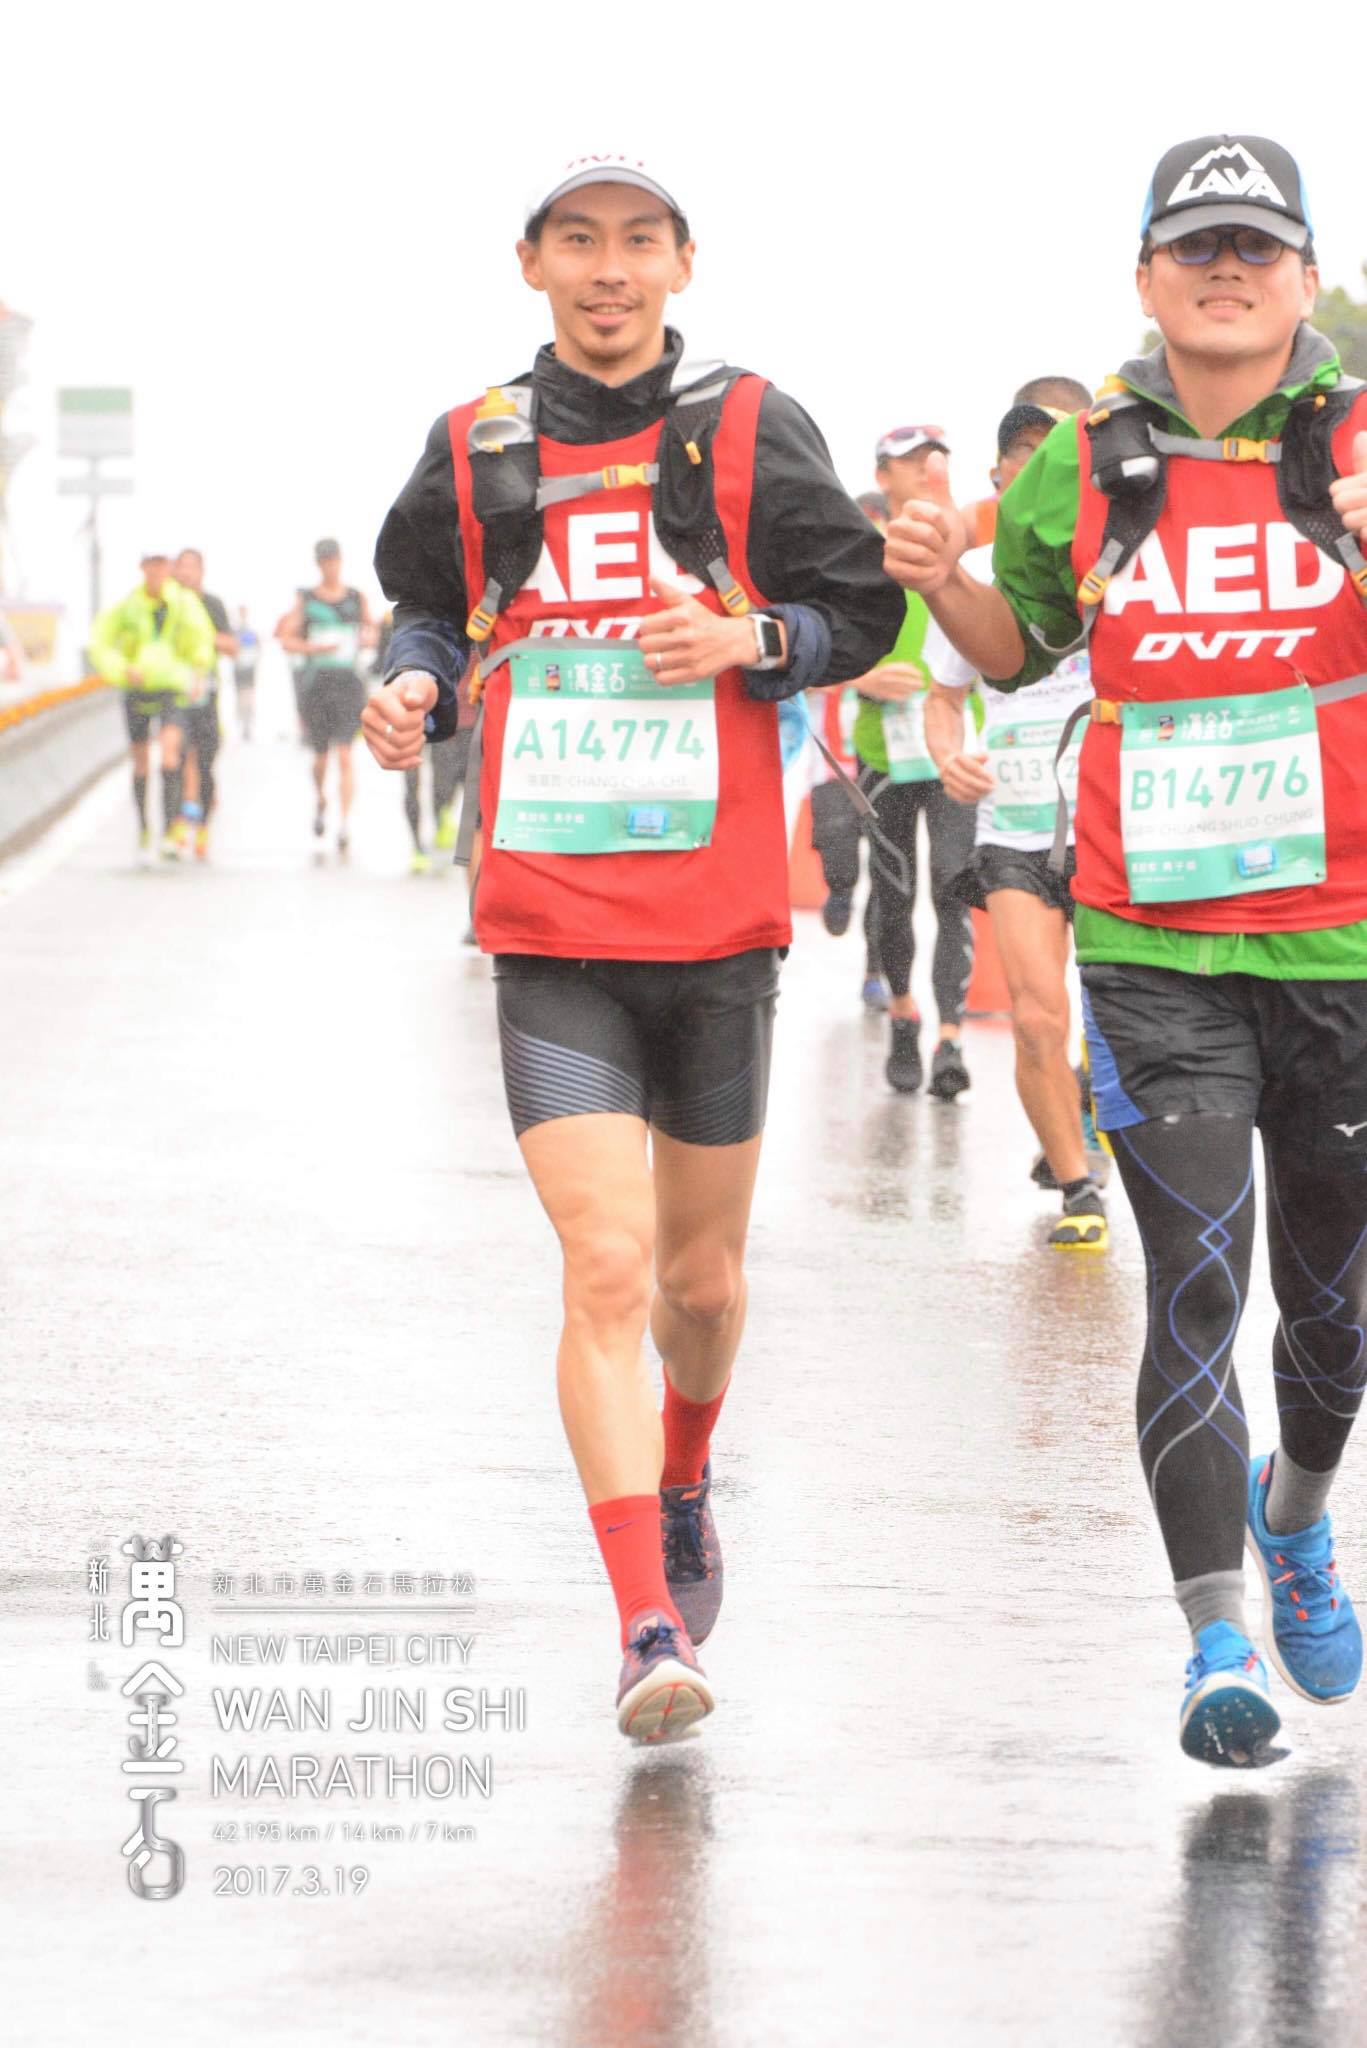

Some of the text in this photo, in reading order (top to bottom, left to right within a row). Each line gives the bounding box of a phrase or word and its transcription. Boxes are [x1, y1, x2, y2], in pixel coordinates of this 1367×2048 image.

[1166, 166, 1287, 207] LAVA
[1104, 521, 1345, 616] AED
[1132, 627, 1317, 662] DVTT
[513, 718, 705, 762] A14774
[1130, 755, 1309, 811] B14776
